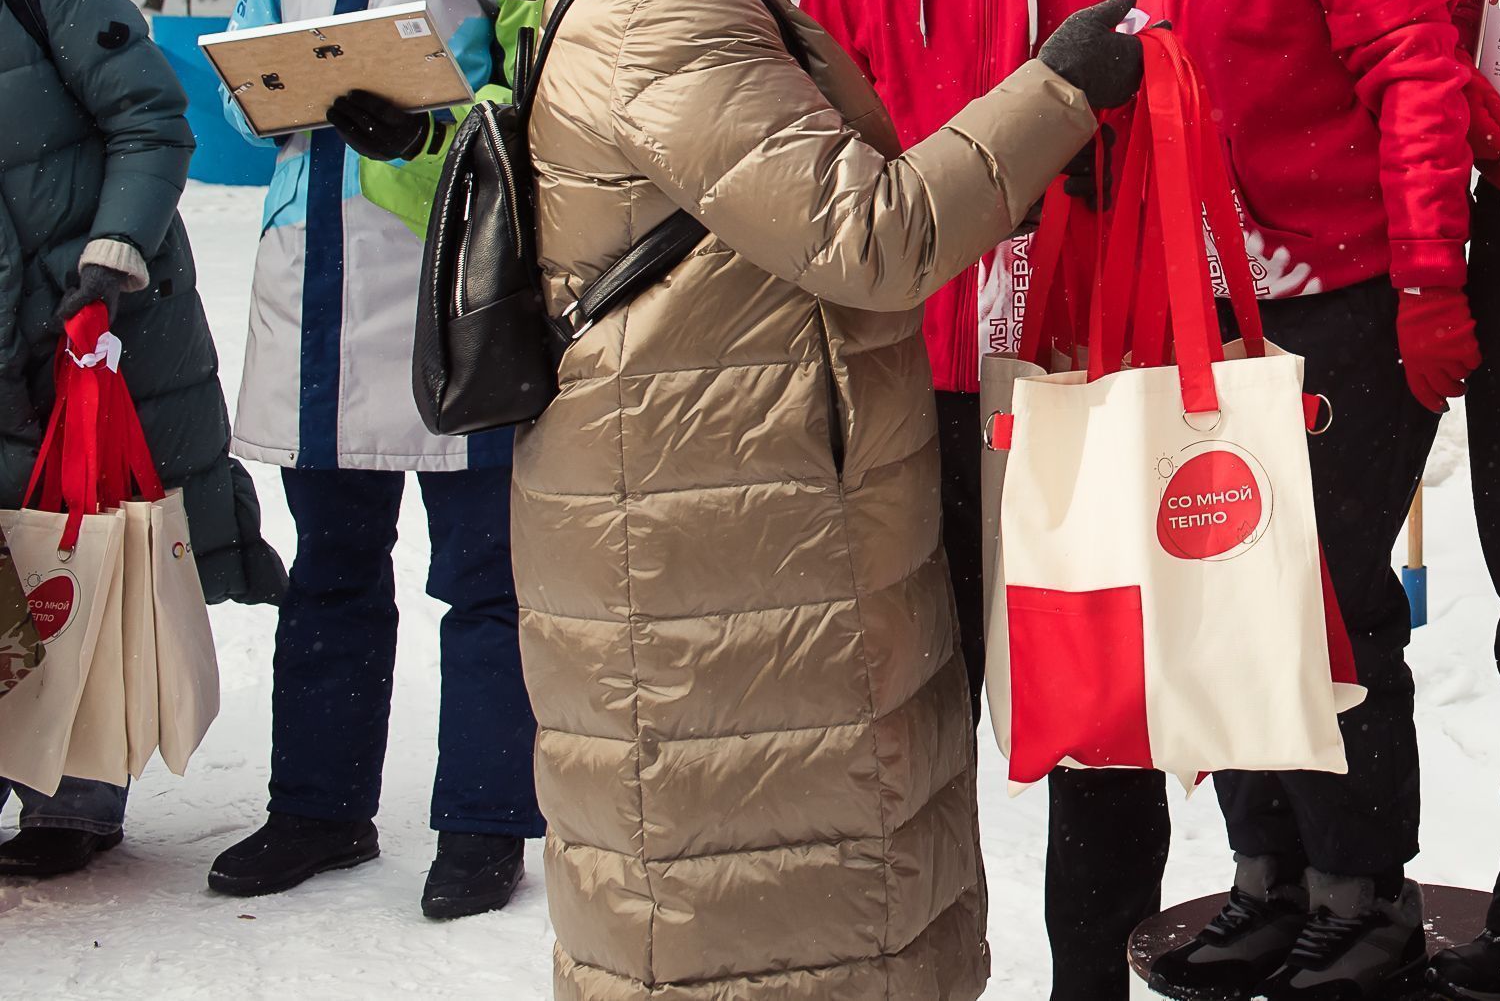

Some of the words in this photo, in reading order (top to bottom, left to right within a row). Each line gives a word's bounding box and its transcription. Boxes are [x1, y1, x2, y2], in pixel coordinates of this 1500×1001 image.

[1167, 495, 1193, 510] СО
[1196, 484, 1253, 507] МНОЙ
[1168, 510, 1228, 530] ТЕПЛО
[27, 599, 43, 609] СО
[44, 600, 70, 611] МНОЙ
[32, 612, 55, 623] ЕПЛО
